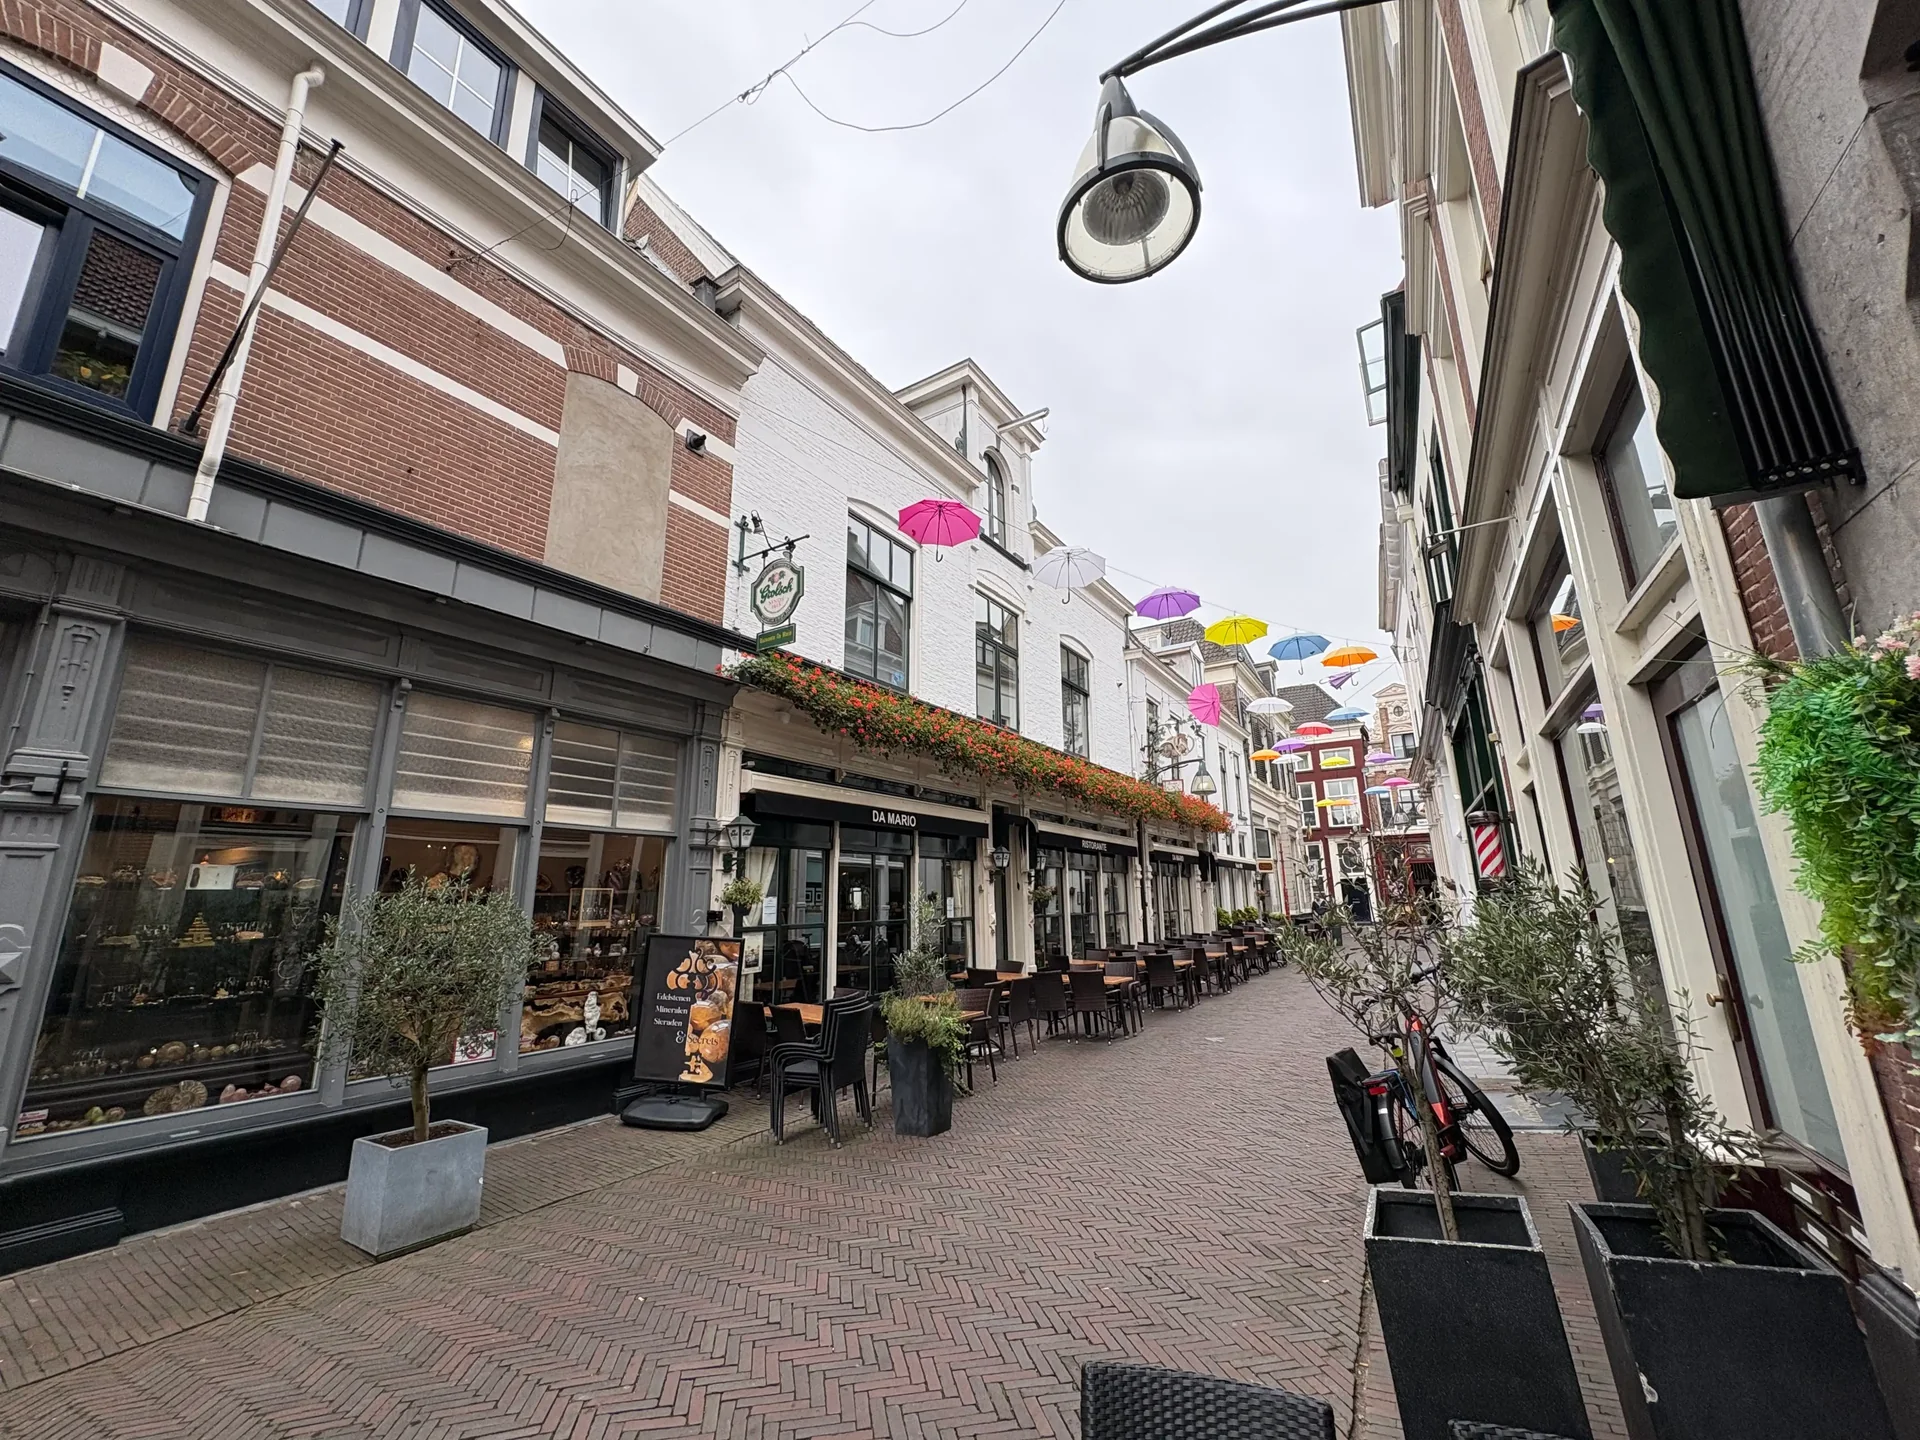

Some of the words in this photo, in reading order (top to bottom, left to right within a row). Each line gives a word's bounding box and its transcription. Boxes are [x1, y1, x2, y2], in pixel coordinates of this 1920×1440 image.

[760, 578, 794, 604] Grolsch
[872, 810, 886, 823] DA
[888, 812, 916, 827] MARIO
[1082, 840, 1107, 852] RISTORANTE
[657, 992, 691, 1002] Edelstenen
[655, 1005, 688, 1014] Mineralen
[654, 1018, 682, 1026] Sieraden
[676, 1030, 686, 1044] &
[688, 1034, 718, 1046] Secrets
